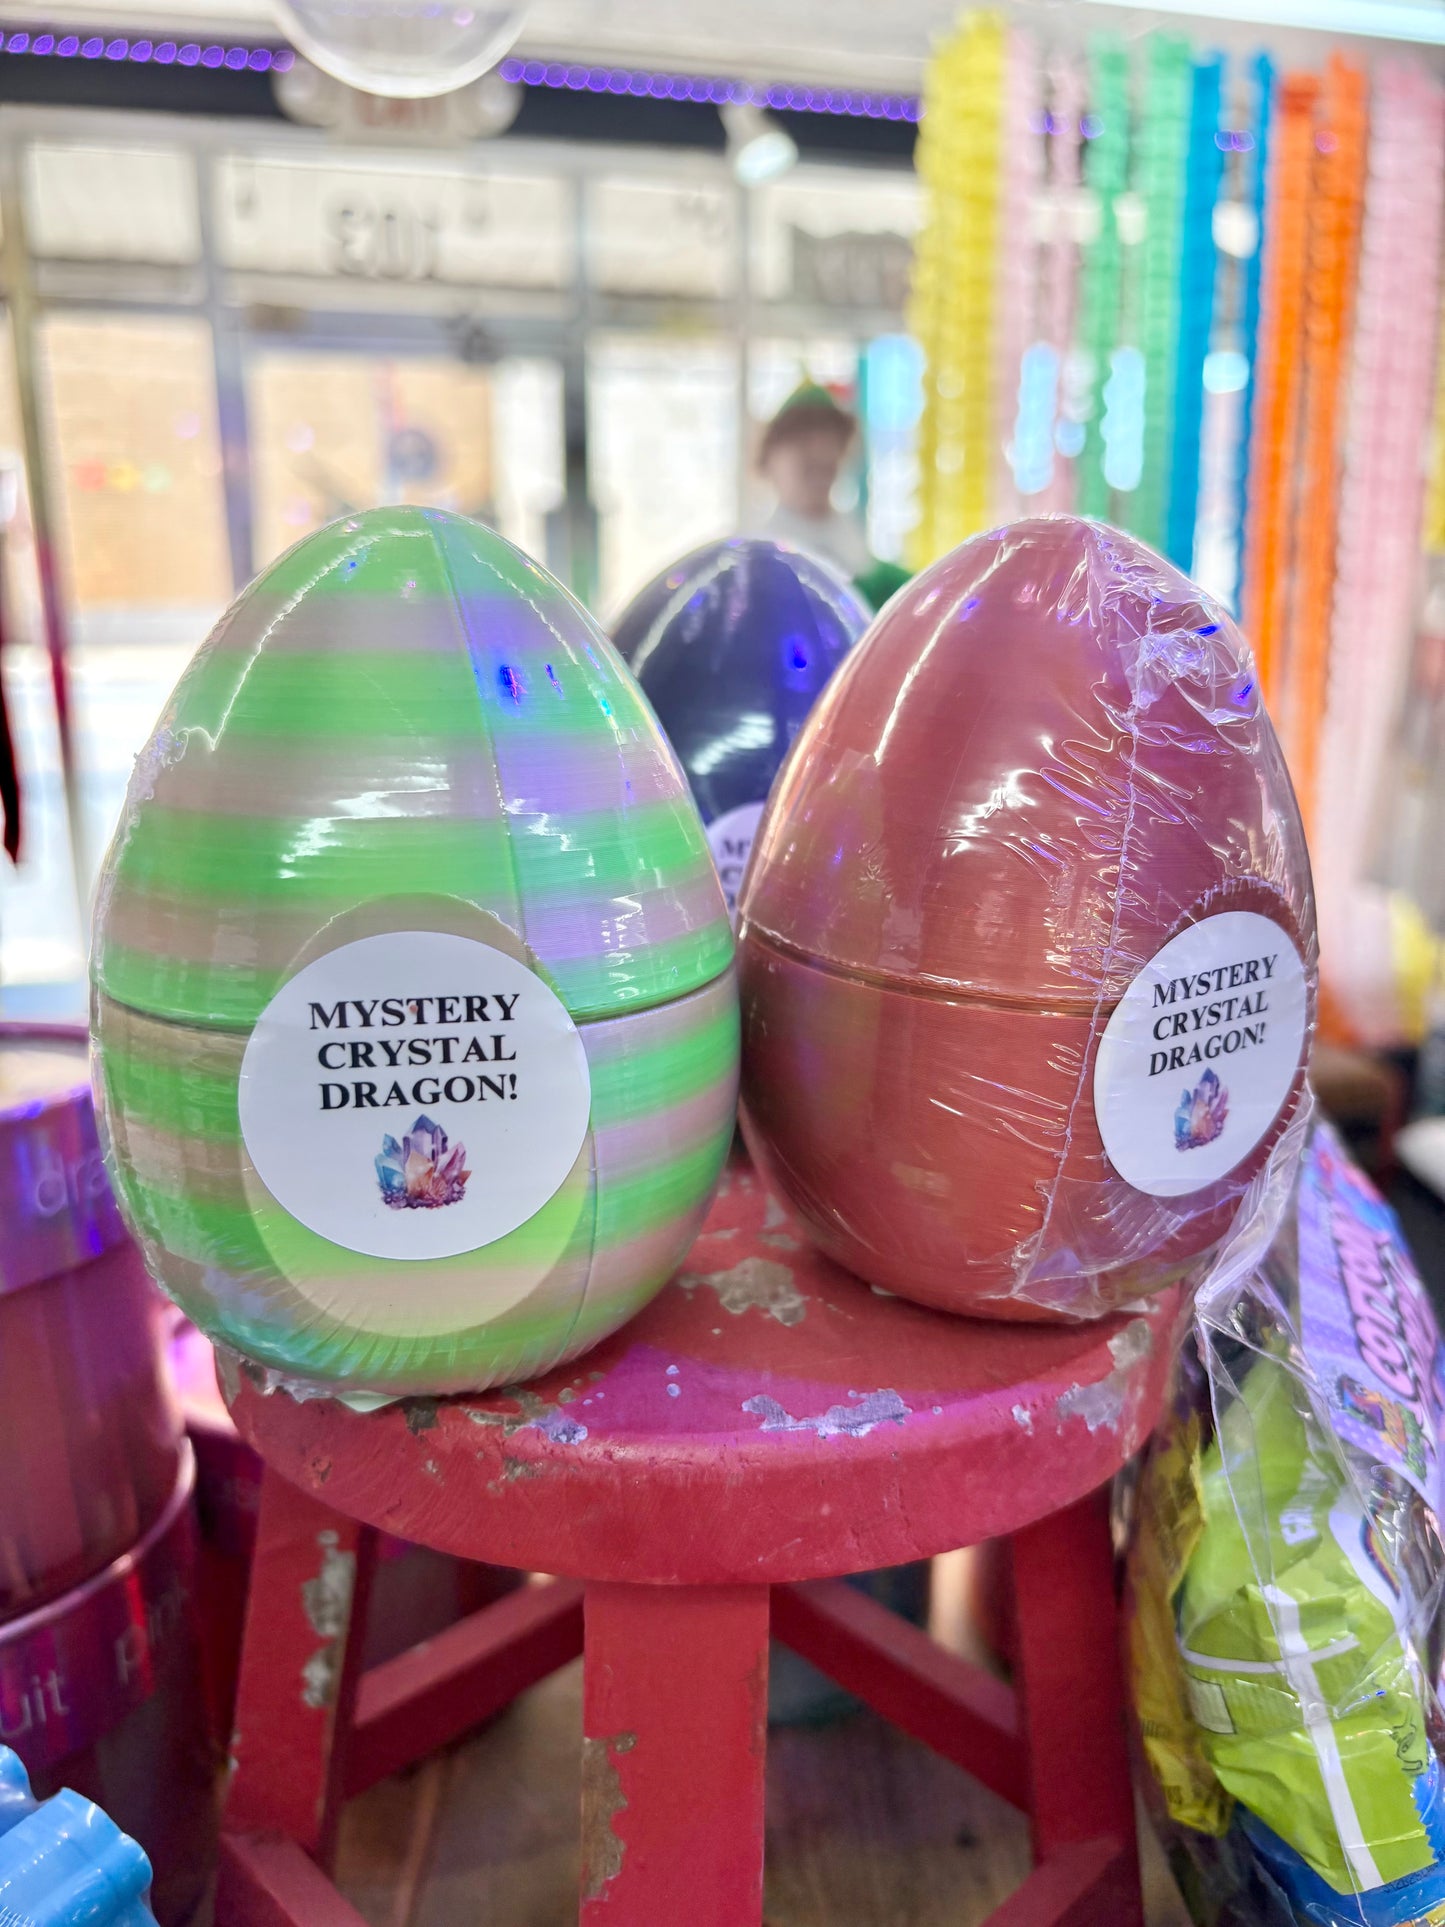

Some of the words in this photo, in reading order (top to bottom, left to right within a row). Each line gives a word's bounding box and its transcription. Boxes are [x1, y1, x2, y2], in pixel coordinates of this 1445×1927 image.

[1152, 954, 1278, 1008] MYSTERY
[308, 993, 520, 1030] MYSTERY
[1152, 990, 1269, 1041] CRYSTAL
[317, 1034, 517, 1070] CRYSTAL
[1148, 1022, 1267, 1077] DRAGON!
[318, 1073, 518, 1110] DRAGON!
